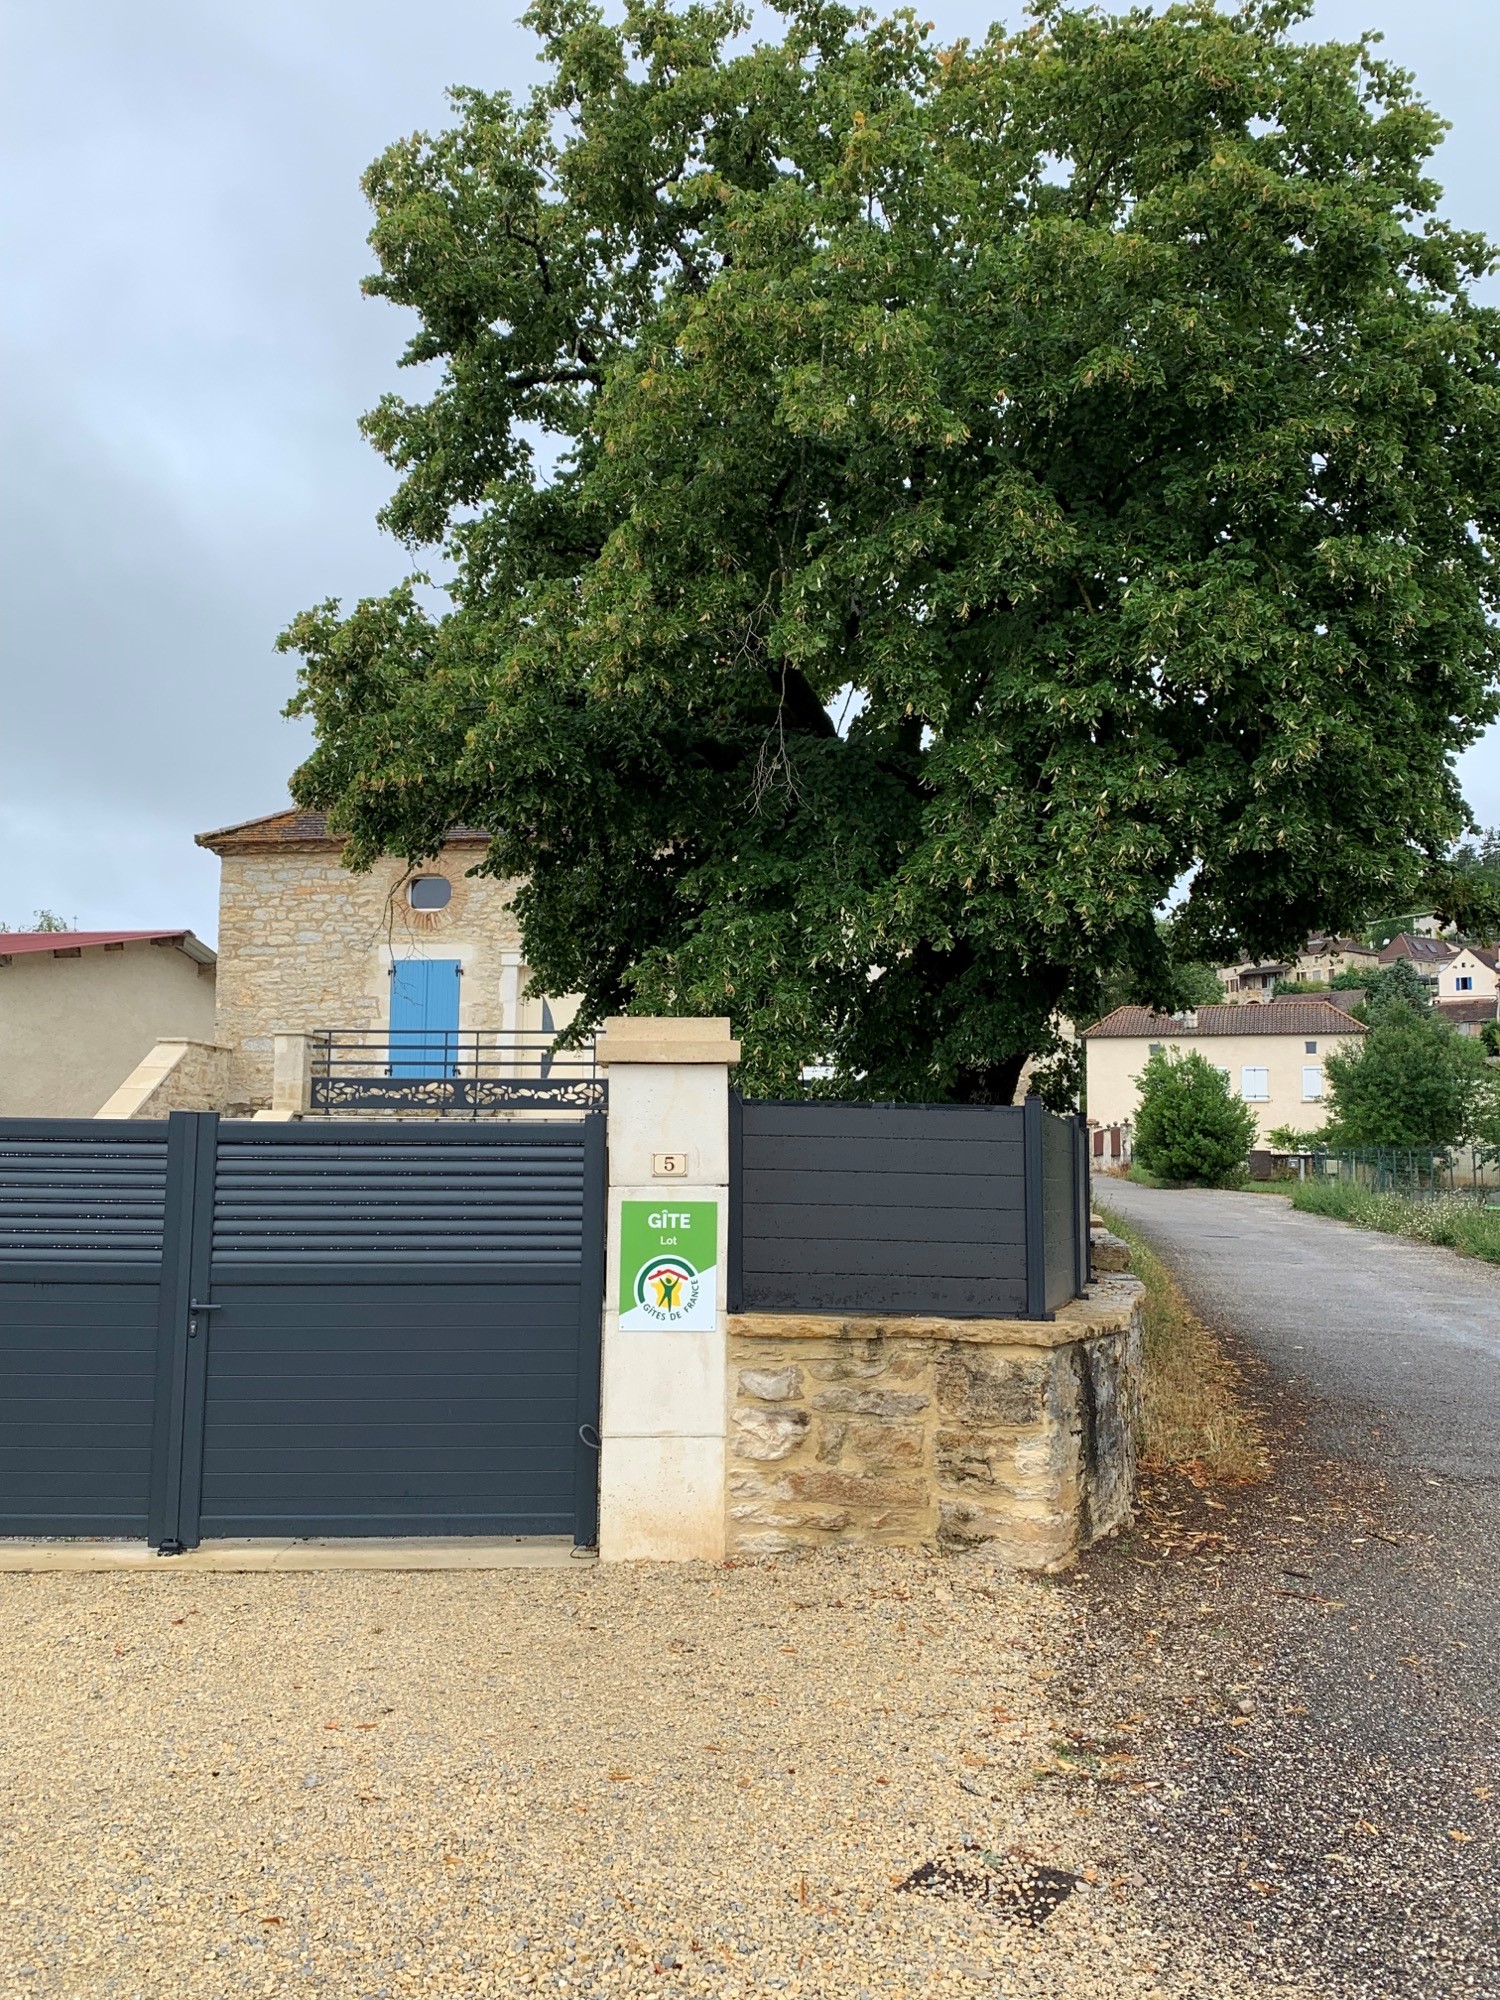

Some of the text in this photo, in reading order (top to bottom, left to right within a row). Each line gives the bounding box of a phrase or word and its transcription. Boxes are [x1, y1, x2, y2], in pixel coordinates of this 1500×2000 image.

[664, 1156, 675, 1171] 5
[647, 1209, 691, 1229] GÎTE
[660, 1236, 677, 1245] Lot
[643, 1279, 700, 1321] GÎTES DE FRANCE
